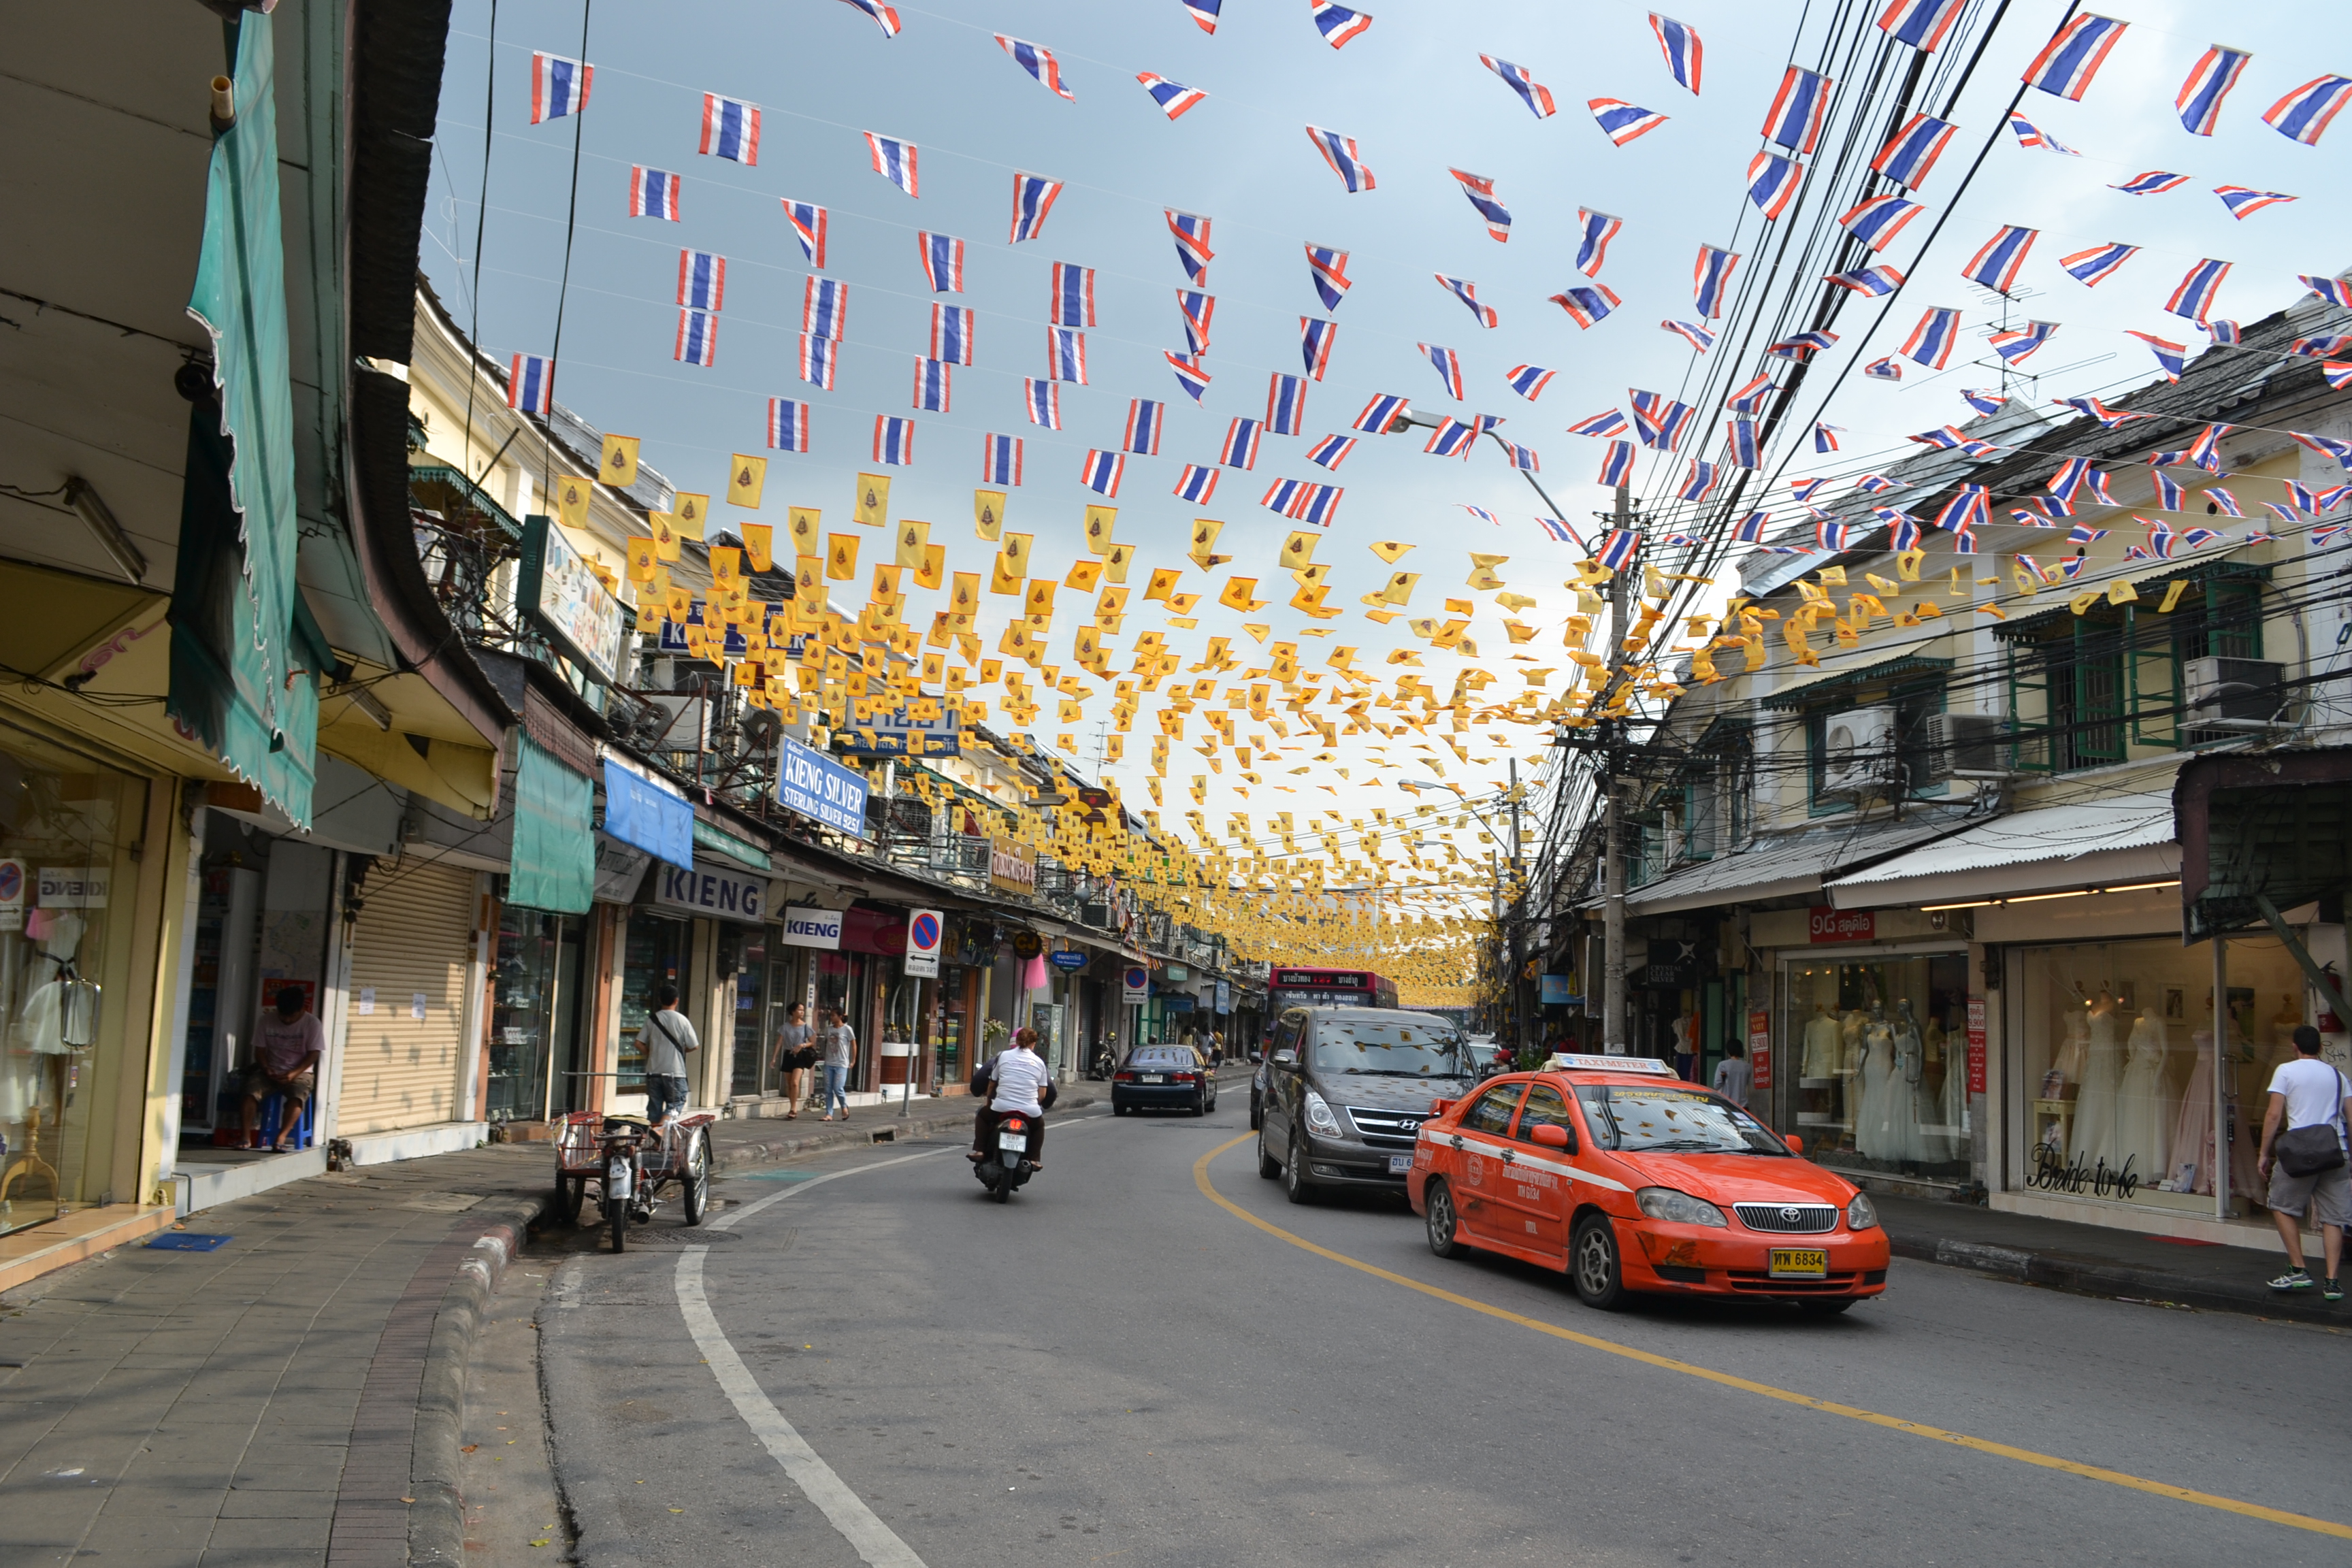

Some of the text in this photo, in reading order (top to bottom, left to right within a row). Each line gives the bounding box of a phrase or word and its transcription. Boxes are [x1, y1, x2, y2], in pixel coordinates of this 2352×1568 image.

[785, 753, 863, 815] KIENG SILVER
[783, 786, 819, 815] STERLING
[819, 803, 842, 826] SILVER
[665, 867, 759, 916] KIENG
[787, 919, 839, 938] KIENG
[1015, 935, 1038, 951] CJ
[908, 964, 936, 974] ตลอดเวลา
[1283, 972, 1311, 983] บางบัวทอง
[1575, 1058, 1649, 1070] TAXI-METER
[1526, 1186, 1540, 1201] 6834
[1795, 1252, 1823, 1266] 6834
